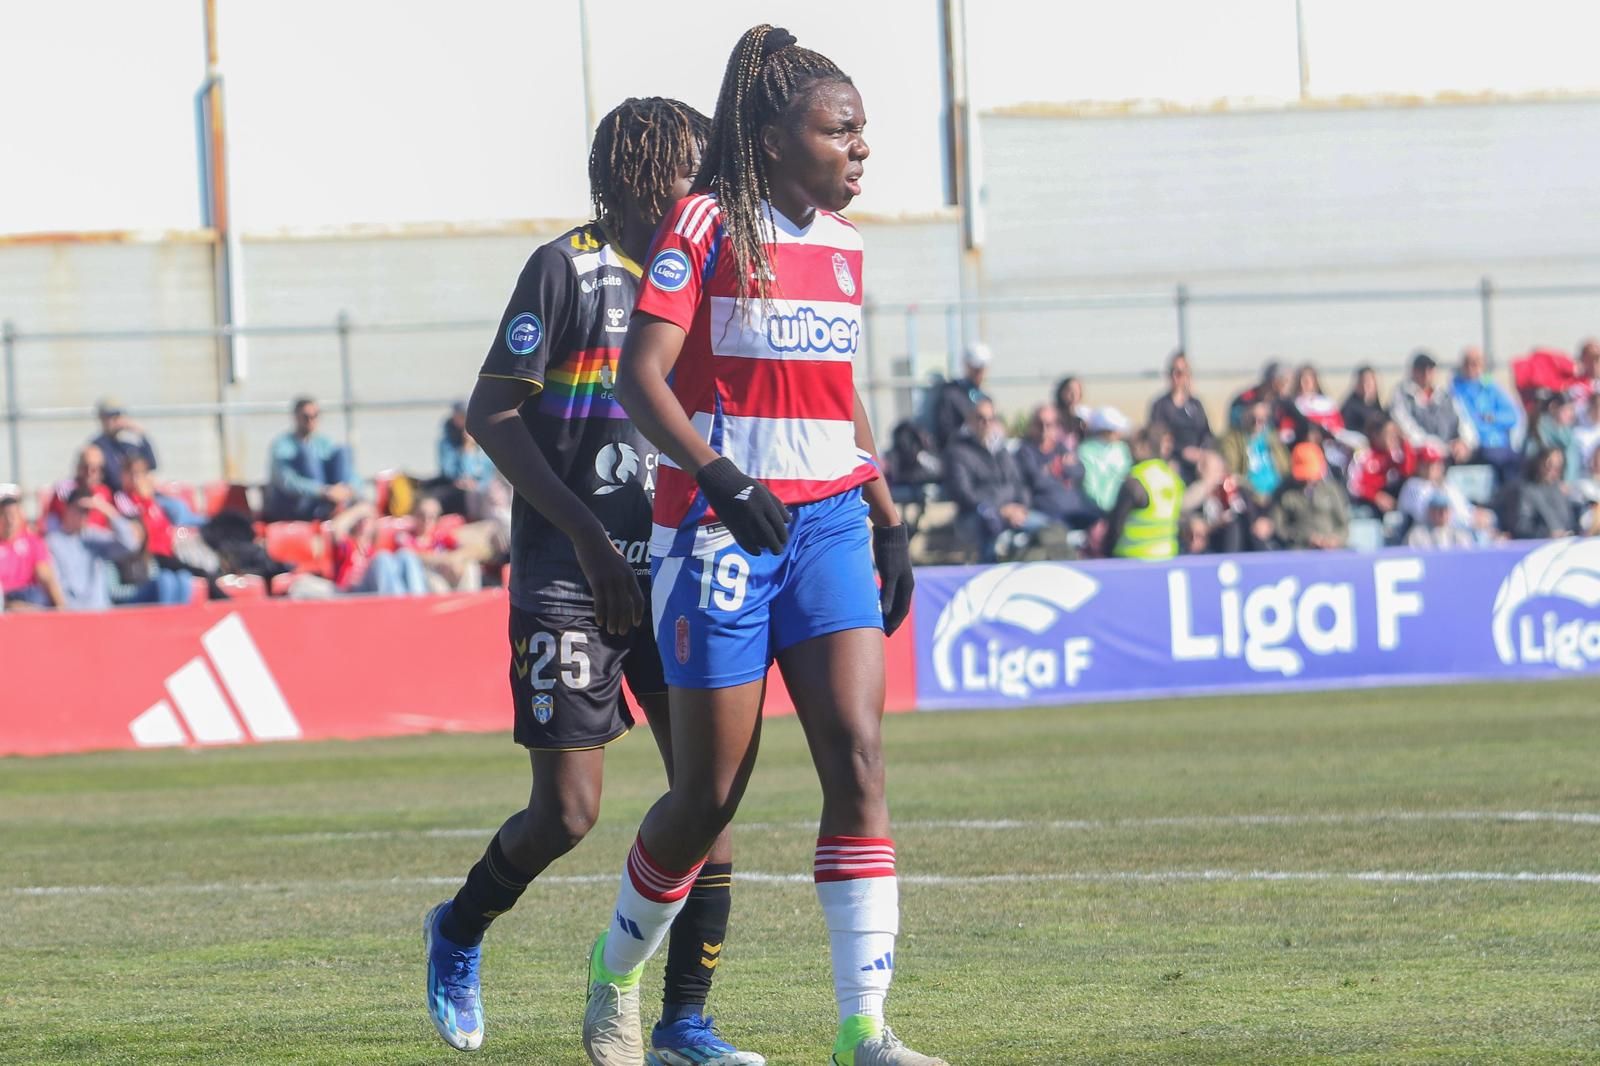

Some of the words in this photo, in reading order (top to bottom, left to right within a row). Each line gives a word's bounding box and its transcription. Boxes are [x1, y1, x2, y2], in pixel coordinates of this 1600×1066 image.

[658, 267, 675, 279] Liga
[675, 273, 681, 281] F
[514, 333, 527, 342] Liga
[767, 307, 859, 353] wiber
[697, 551, 750, 612] 19
[1168, 560, 1357, 677] Liga
[1374, 558, 1425, 651] F
[529, 631, 591, 690] 25
[961, 638, 1058, 698] Liga
[1063, 636, 1095, 687] F
